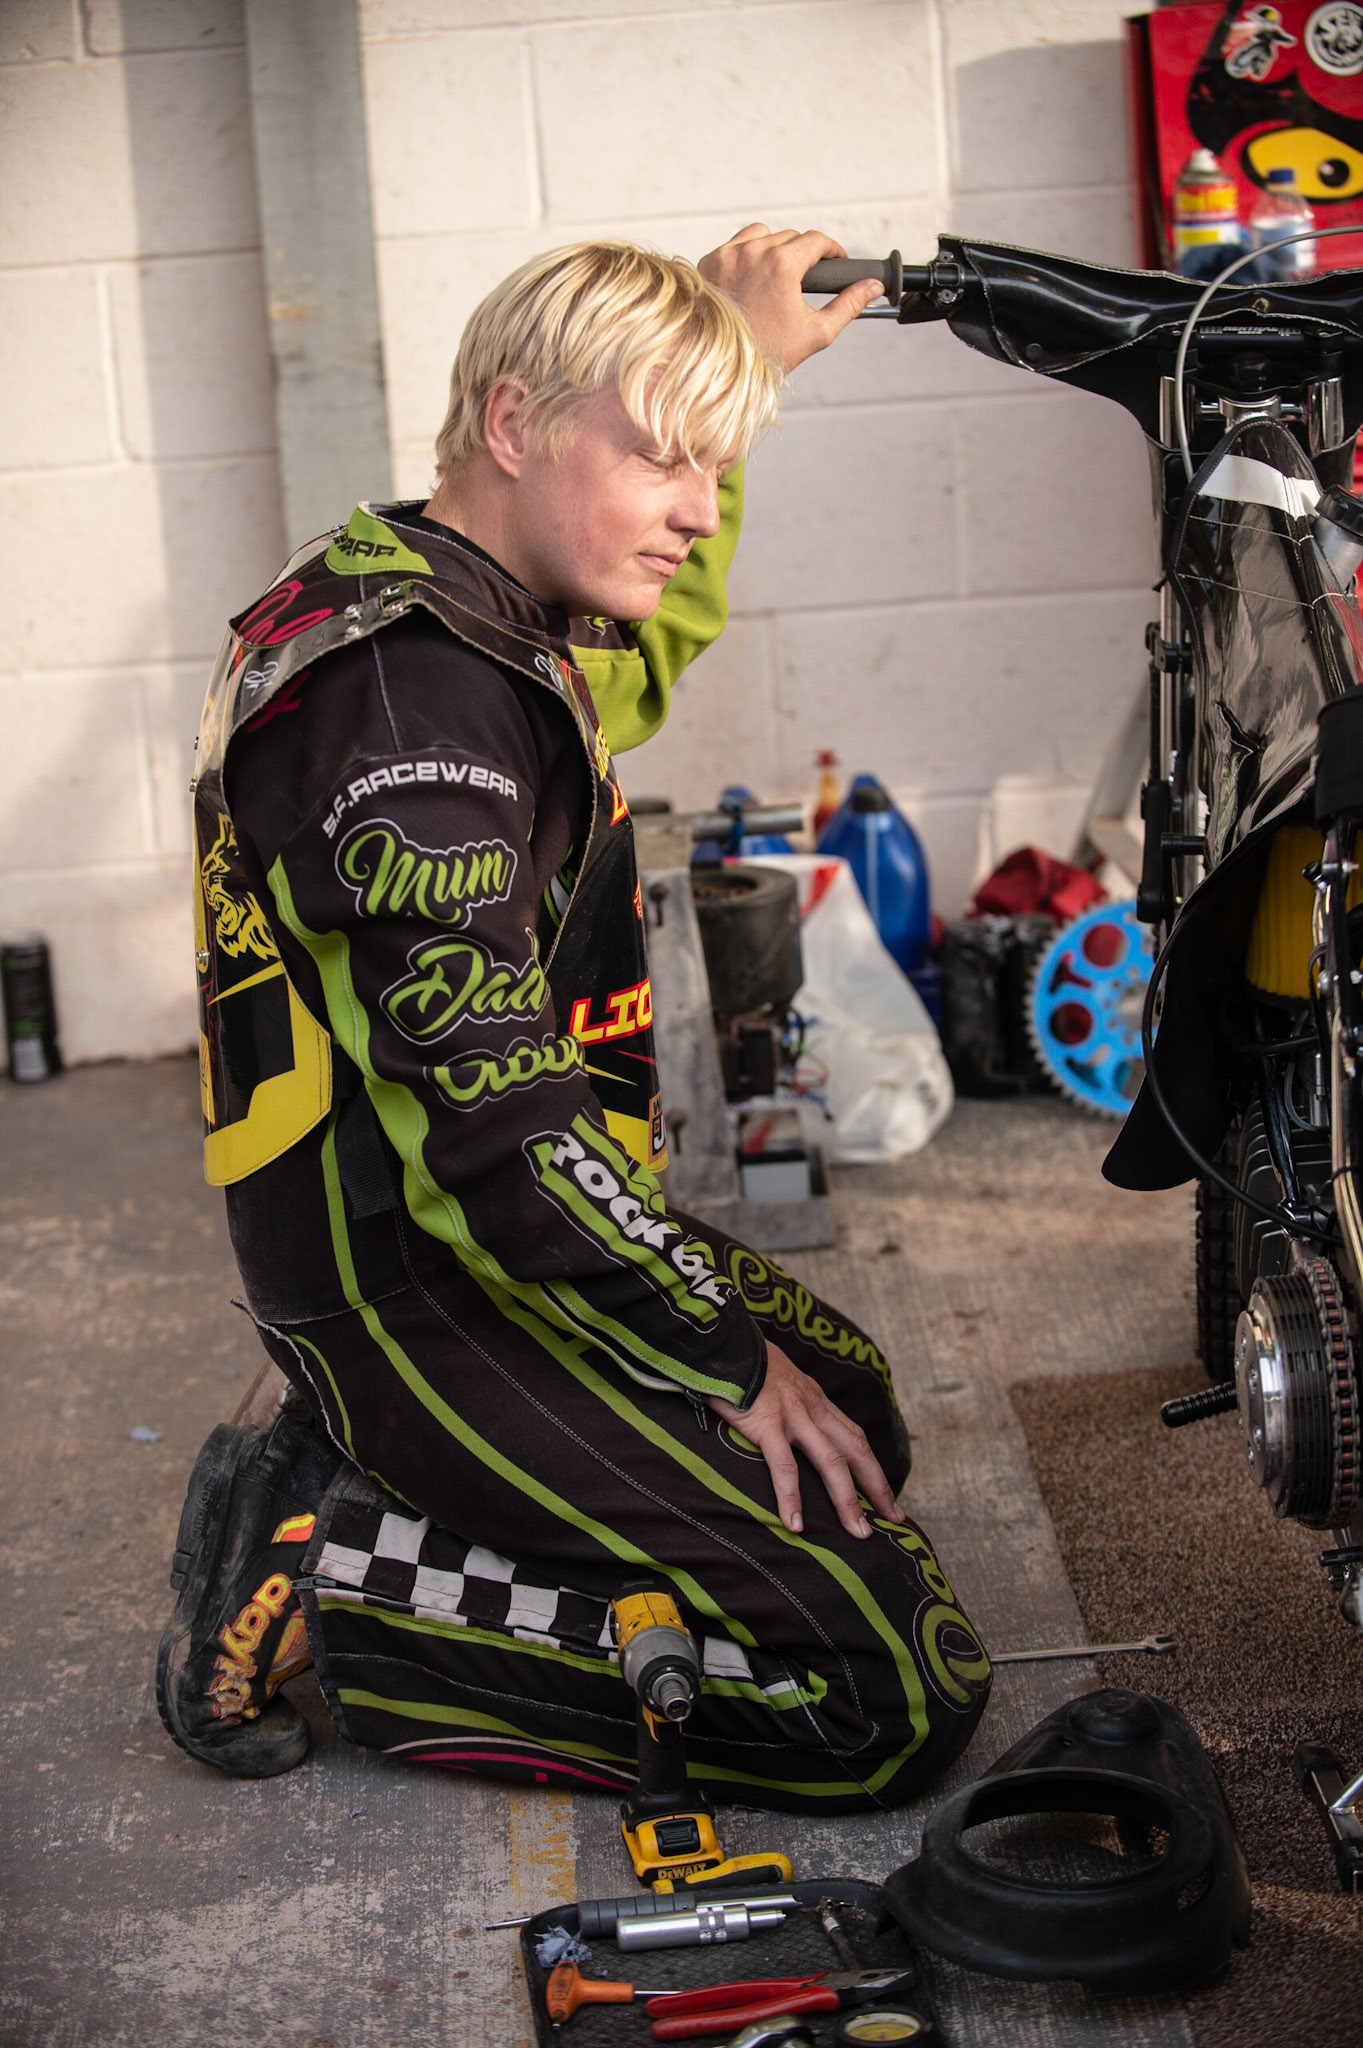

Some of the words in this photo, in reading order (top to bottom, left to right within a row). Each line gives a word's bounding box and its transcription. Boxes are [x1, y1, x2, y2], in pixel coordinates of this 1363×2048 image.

[343, 828, 511, 924] Mum
[386, 930, 547, 1037] Dad
[549, 1131, 680, 1251] ROCK
